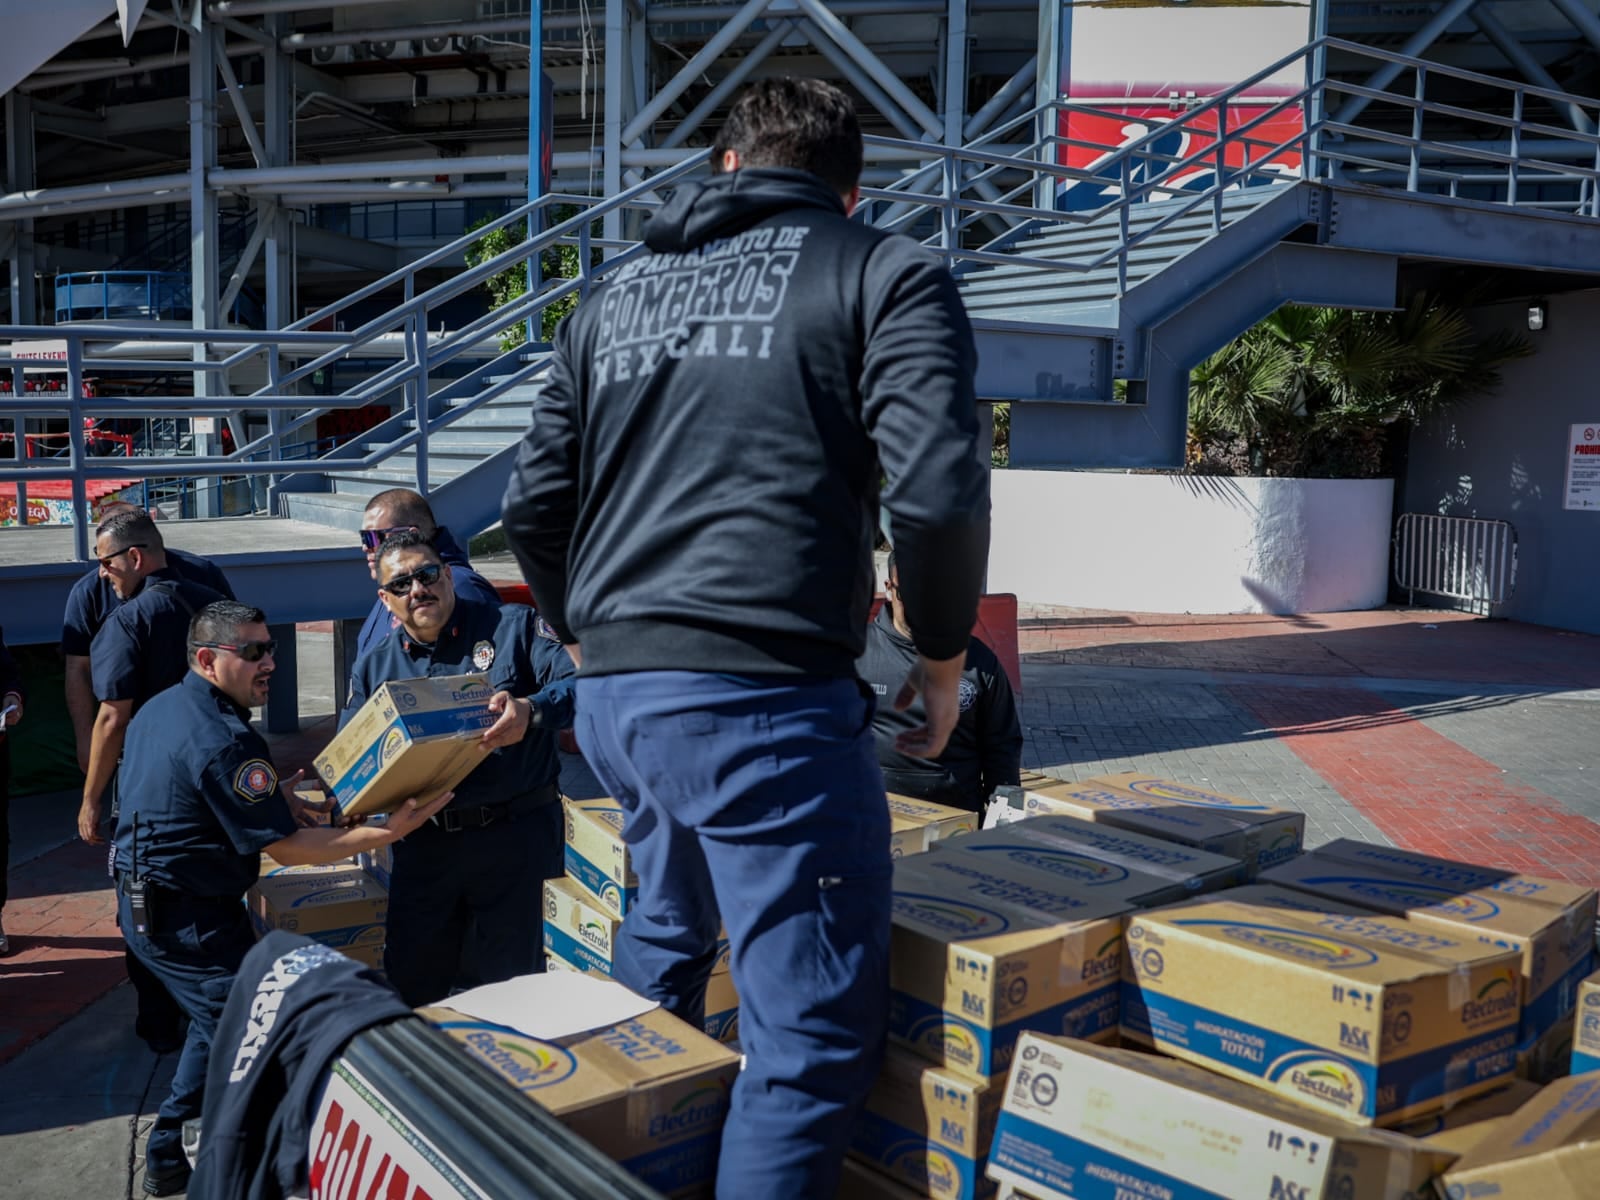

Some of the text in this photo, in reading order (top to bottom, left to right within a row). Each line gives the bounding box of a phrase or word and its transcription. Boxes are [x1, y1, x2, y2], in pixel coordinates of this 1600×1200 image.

[772, 226, 810, 249] DE
[596, 250, 800, 357] BOMBEROS
[579, 922, 610, 952] Electrolit
[1291, 1070, 1355, 1105] Electrolit
